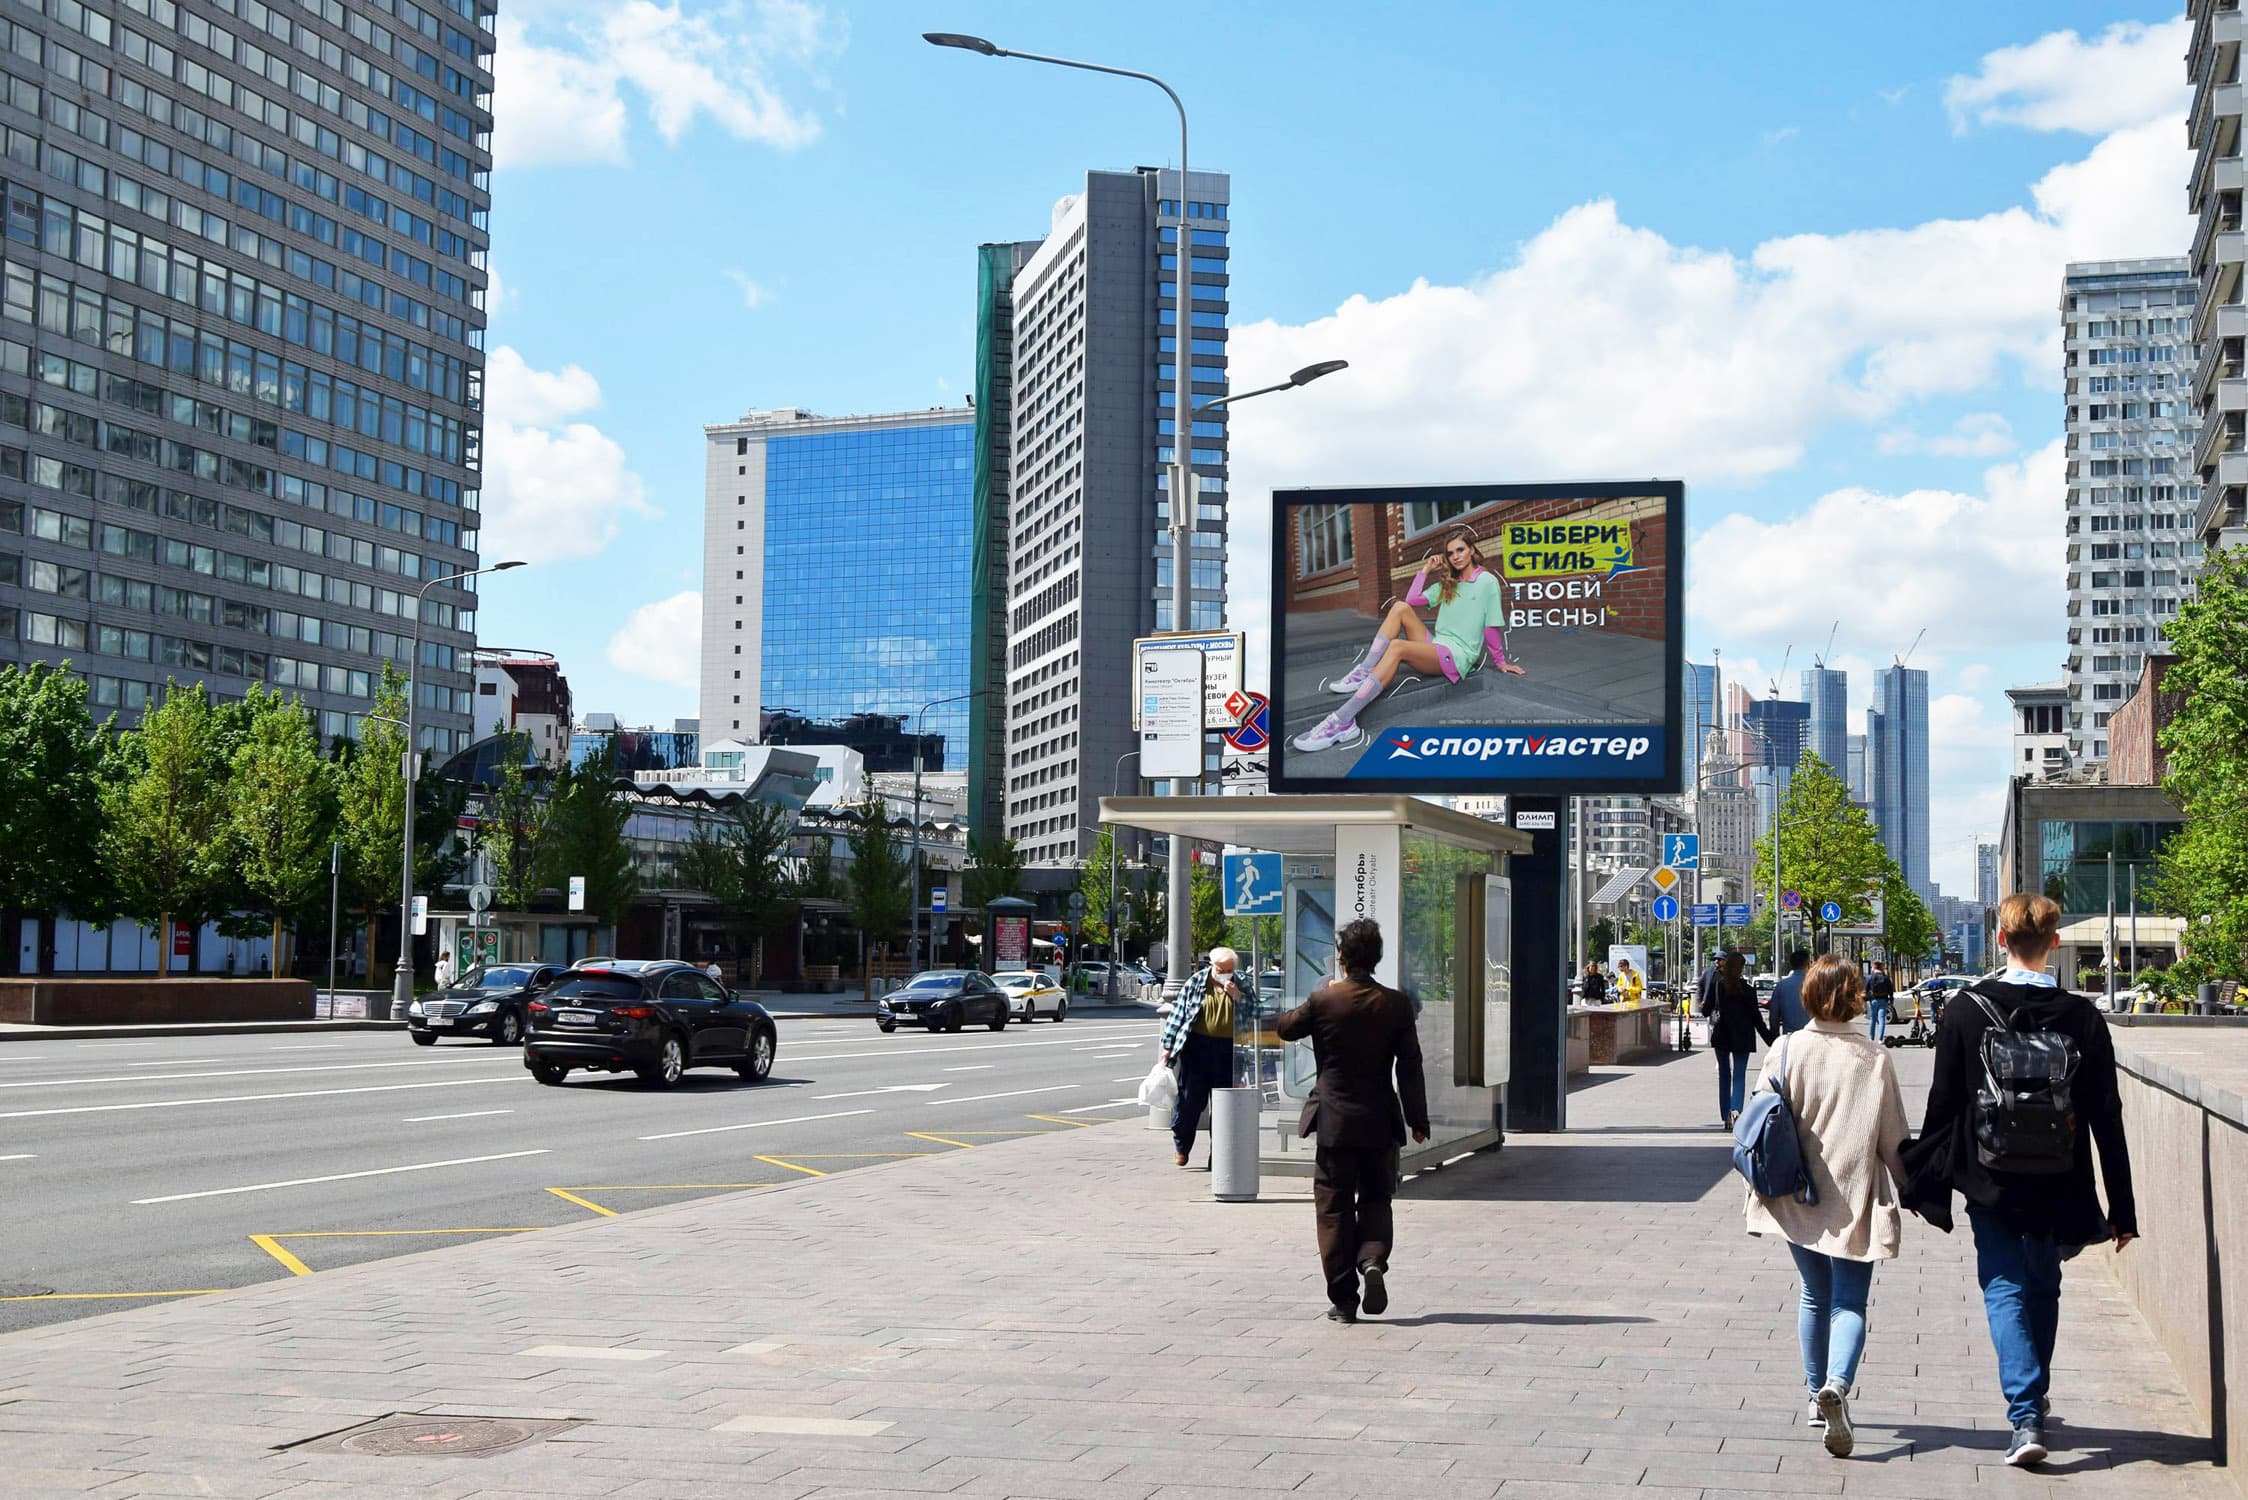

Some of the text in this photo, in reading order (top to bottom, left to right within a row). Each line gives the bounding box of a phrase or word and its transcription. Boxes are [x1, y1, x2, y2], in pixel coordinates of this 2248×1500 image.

[1510, 525, 1619, 545] ВЫБЕРИ
[1509, 551, 1596, 570] СТИЛЬ
[1509, 575, 1601, 600] ТВОЕЙ
[1510, 607, 1605, 627] ВЕСНЫ
[1206, 654, 1232, 662] УРНЫЙ
[1206, 690, 1227, 700] ЕВОЙ
[1368, 854, 1378, 887] Oktyabr
[1354, 853, 1367, 919] «Октябрь»
